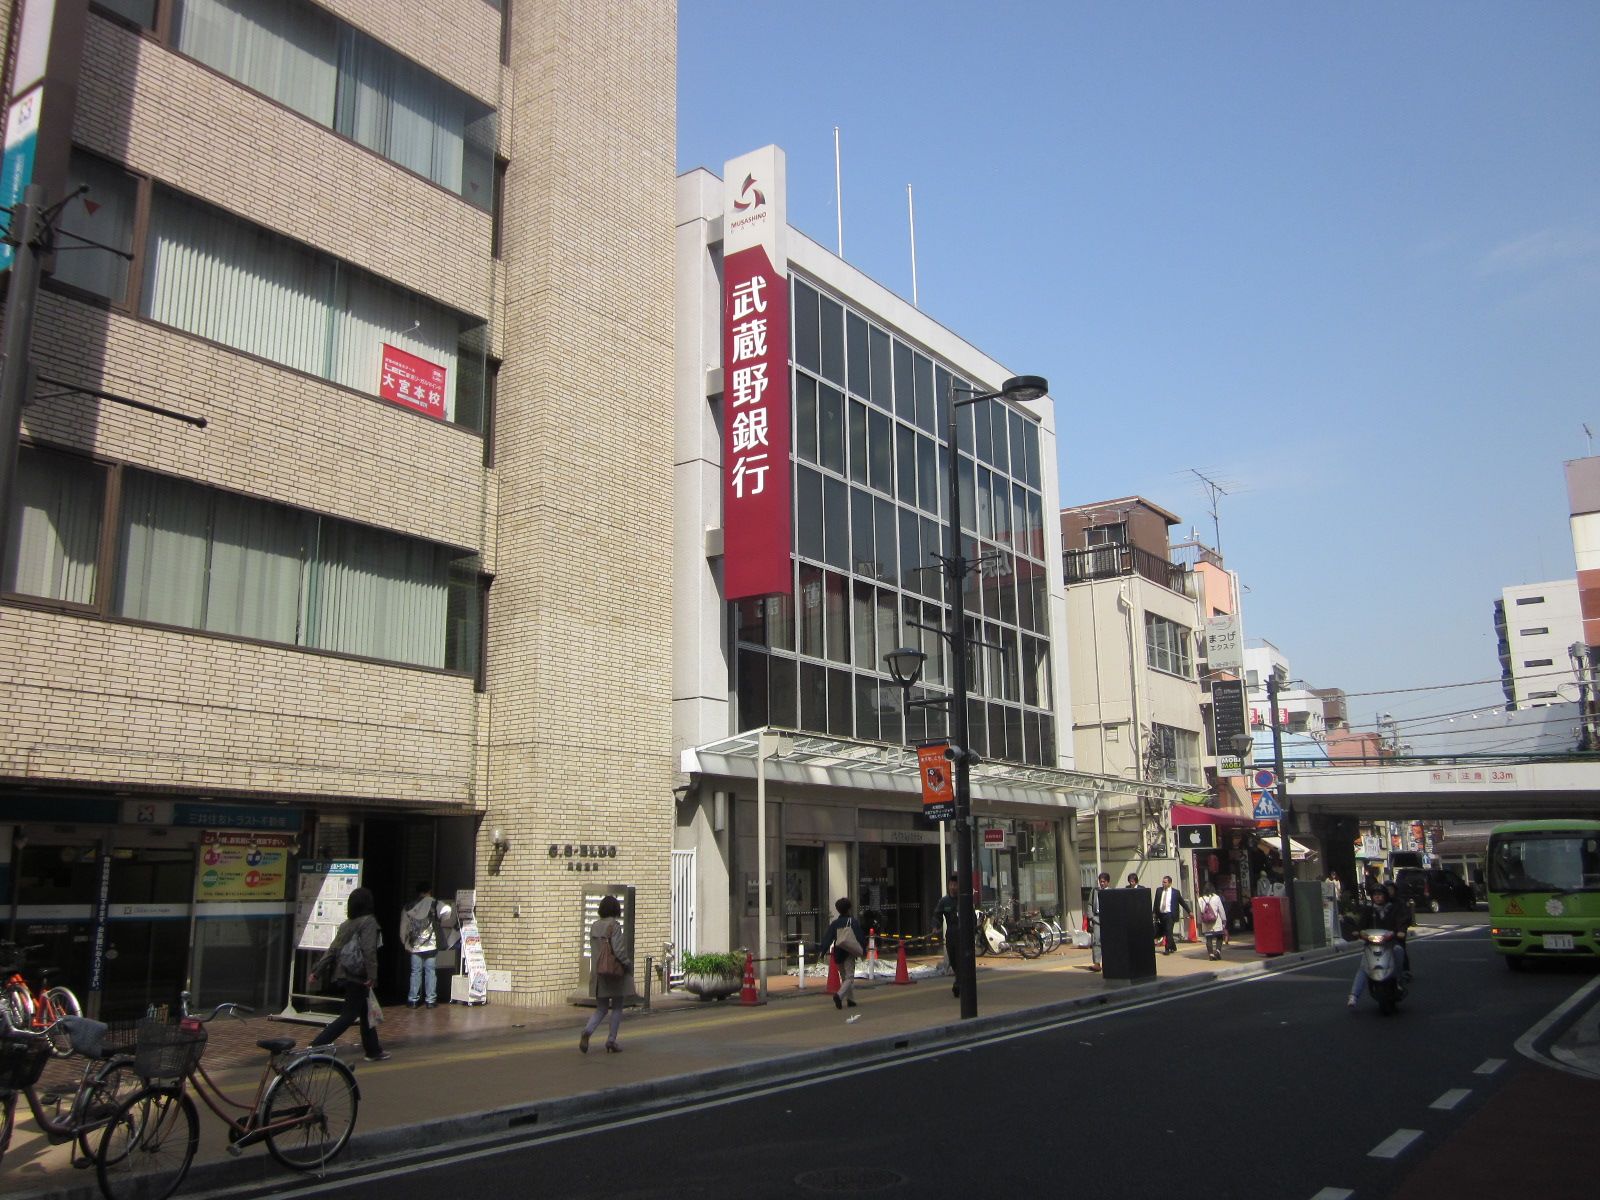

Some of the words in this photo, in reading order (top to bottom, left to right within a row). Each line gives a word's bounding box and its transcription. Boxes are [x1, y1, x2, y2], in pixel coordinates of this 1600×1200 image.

[730, 211, 767, 228] MUSASHINO
[383, 373, 440, 406] 大宮本校
[732, 276, 769, 498] 武蔵野銀行
[1209, 631, 1236, 643] まつげ
[1210, 643, 1235, 651] エクステ
[1492, 771, 1513, 780] 3.3m
